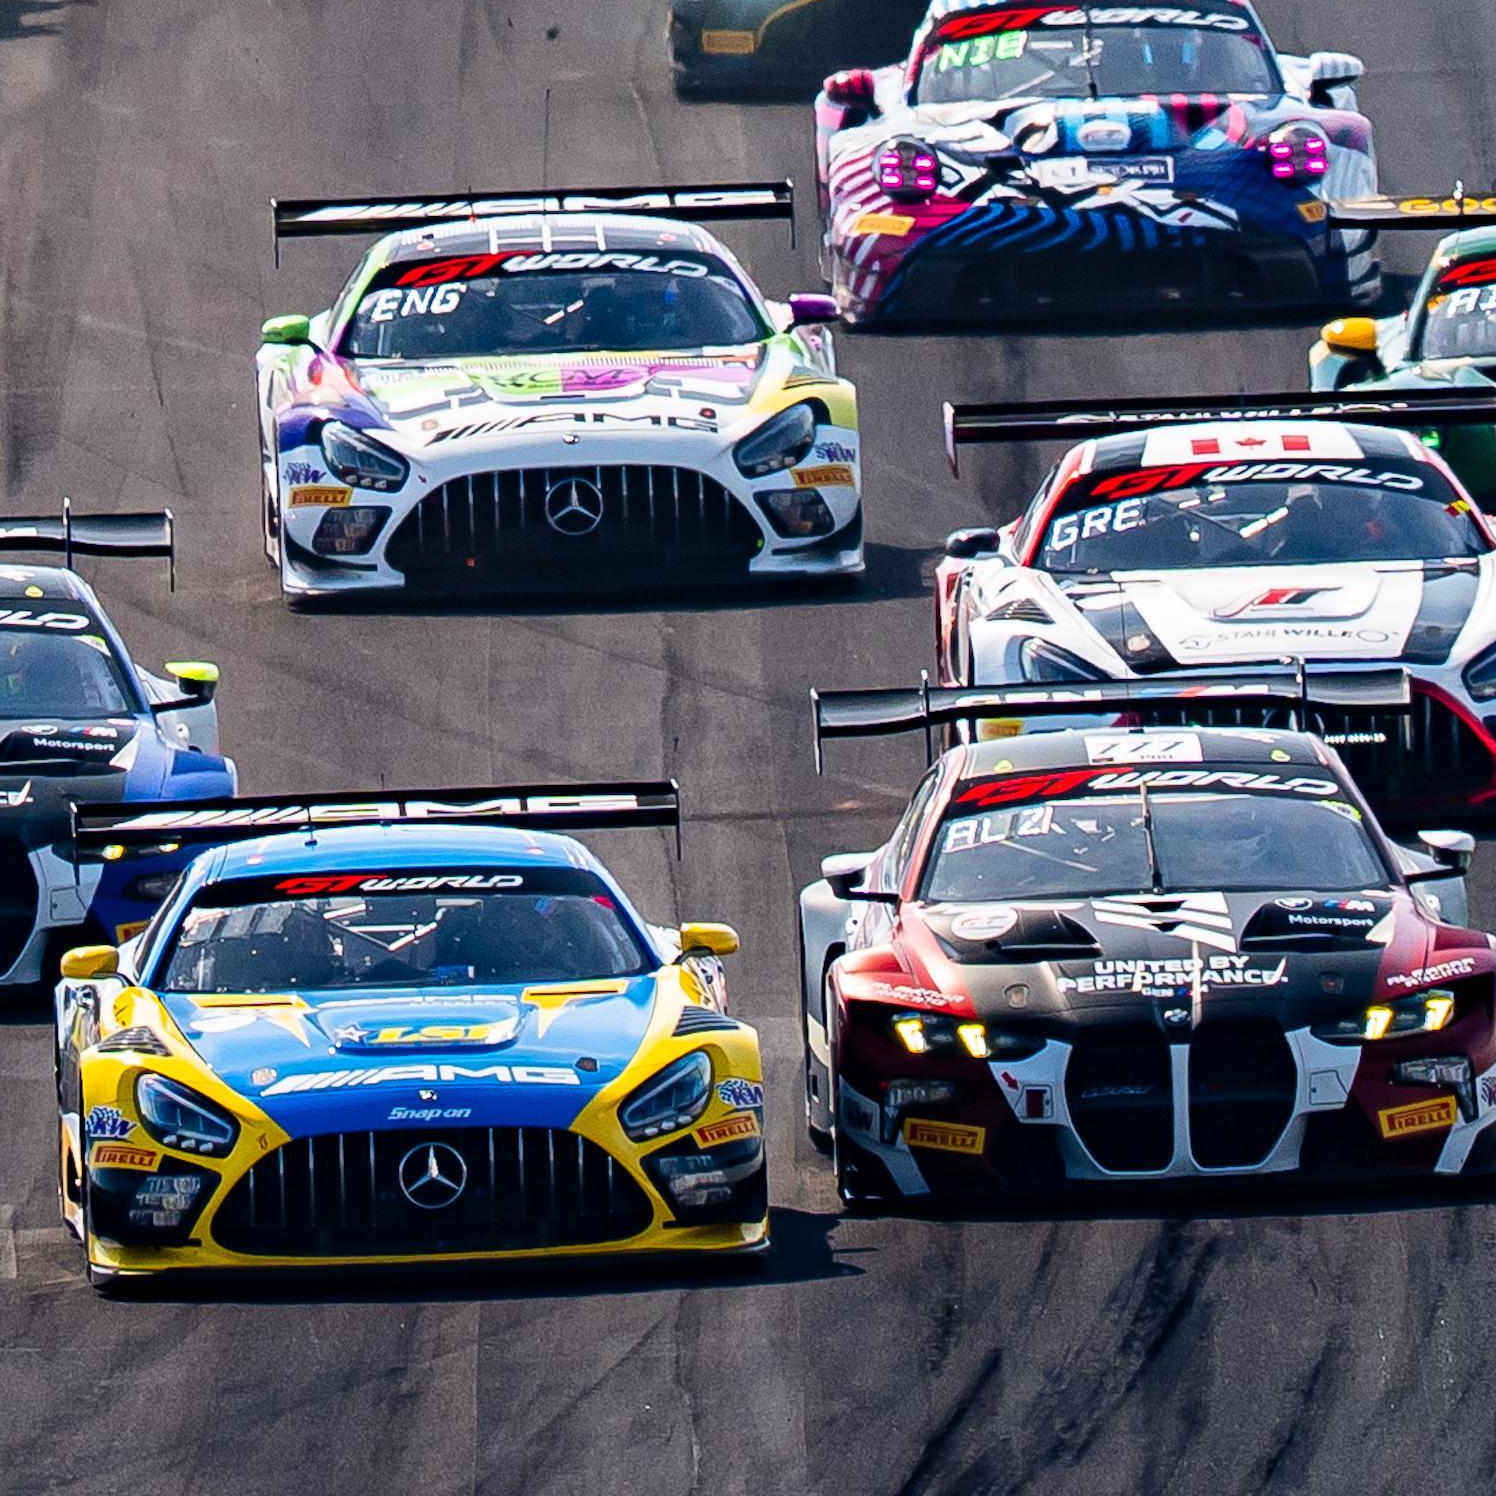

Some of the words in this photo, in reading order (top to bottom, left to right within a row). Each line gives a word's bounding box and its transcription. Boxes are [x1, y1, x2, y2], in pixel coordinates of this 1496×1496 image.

[501, 253, 708, 276] WORLD
[372, 282, 467, 322] ENG
[1204, 464, 1424, 490] WORLD
[1052, 499, 1143, 551] GRE
[32, 737, 116, 752] Motorsport
[1089, 769, 1339, 795] WORLD
[358, 874, 524, 892] WORLD
[1288, 914, 1375, 927] Motorsport
[1094, 958, 1204, 975] UNITED
[1208, 955, 1250, 970] BY
[362, 1064, 582, 1086] AMG
[1387, 1101, 1452, 1132] PIRELLI
[697, 1115, 755, 1143] PIRELLI
[909, 1123, 979, 1149] PIRELLI
[95, 1145, 157, 1167] PIRELLI
